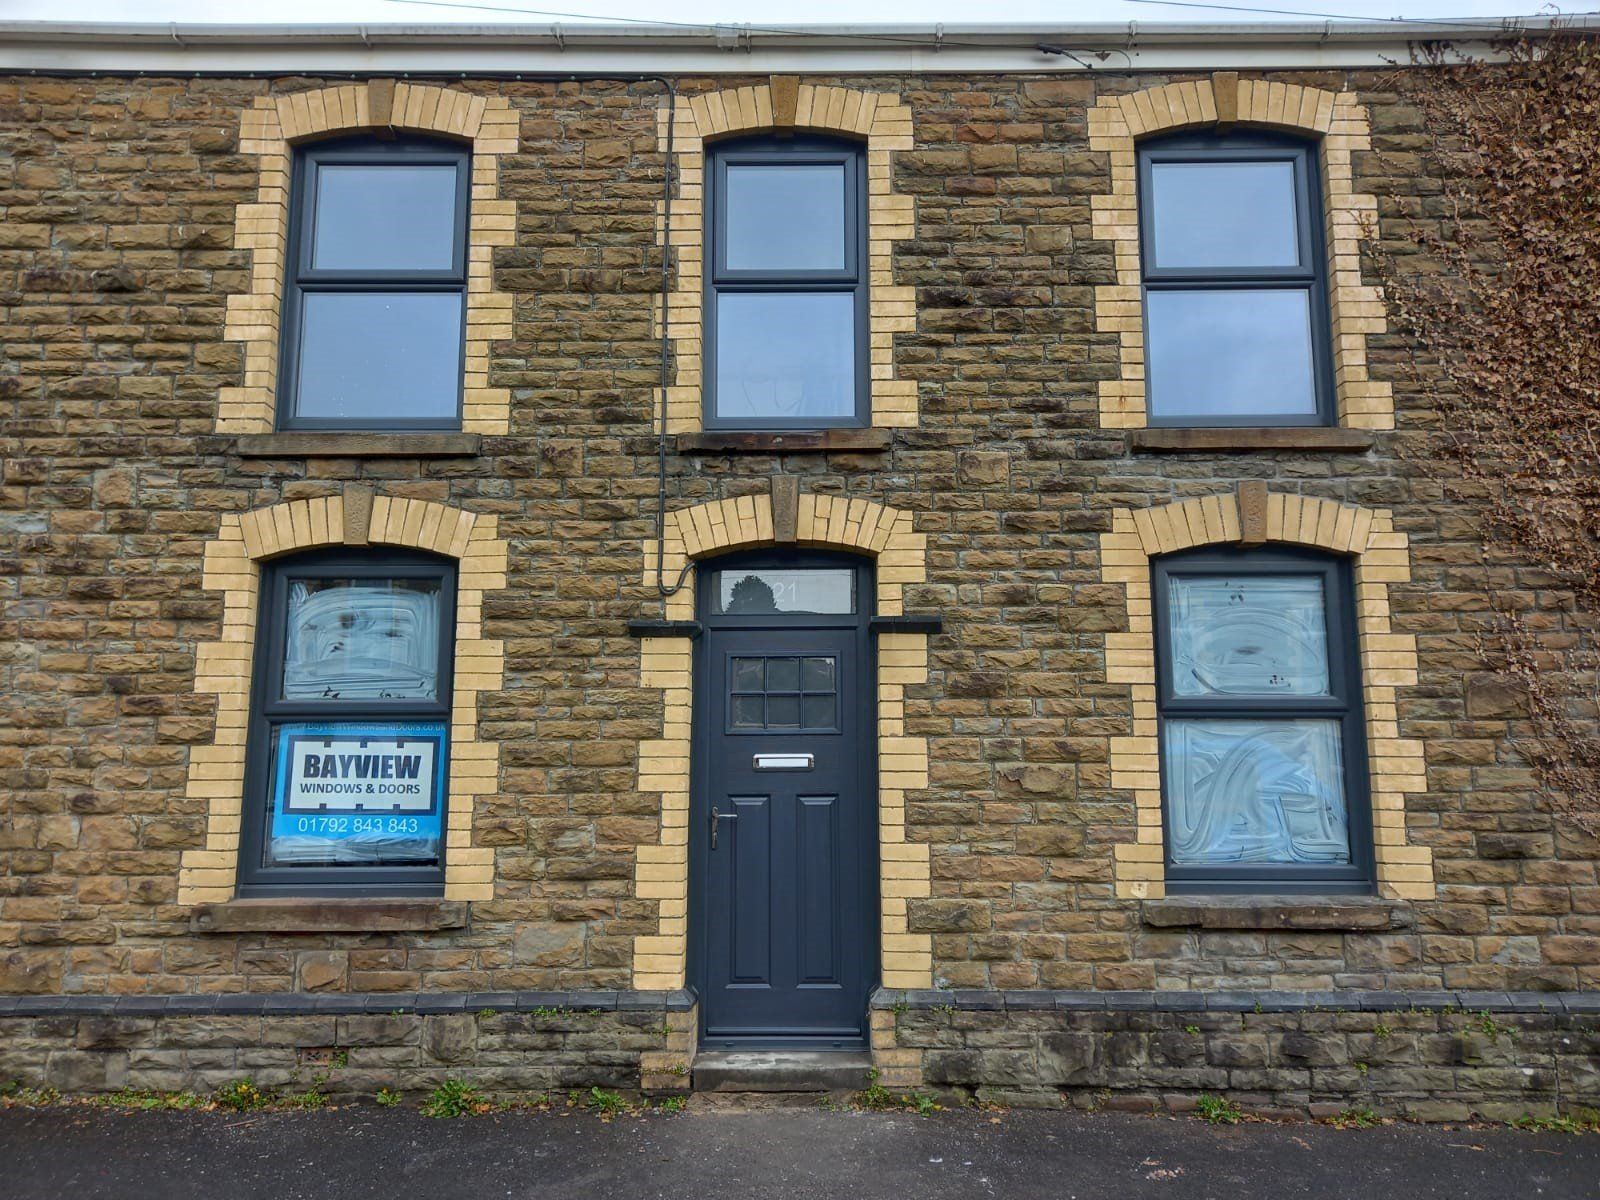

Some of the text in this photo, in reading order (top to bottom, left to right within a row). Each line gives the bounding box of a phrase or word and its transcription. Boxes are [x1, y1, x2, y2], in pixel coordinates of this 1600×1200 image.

[773, 582, 796, 602] 21
[303, 754, 421, 779] BAYVIEW
[300, 783, 421, 795] WINDOWS & DOORS
[298, 818, 418, 833] 01792 843 843
